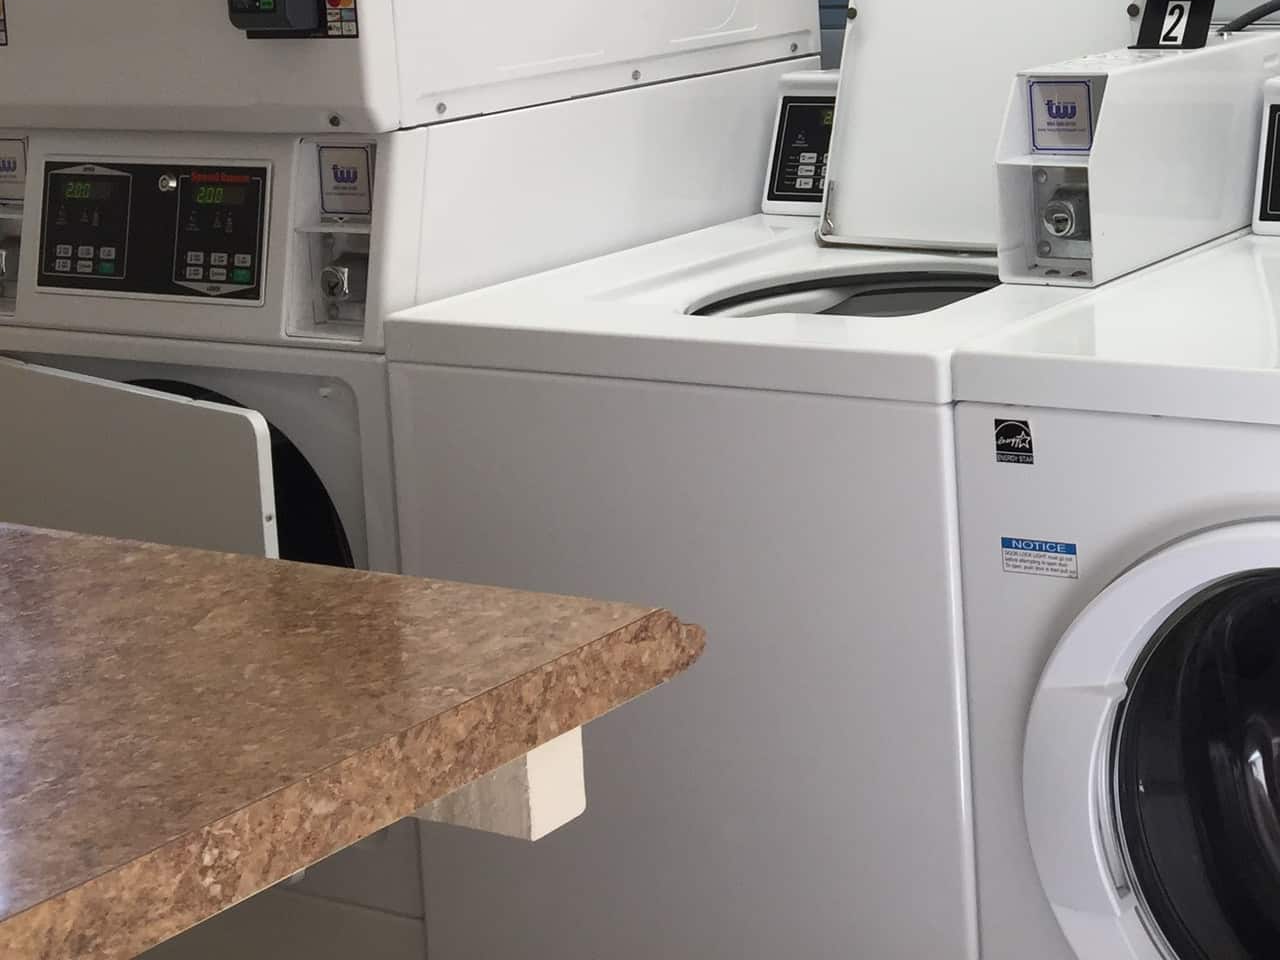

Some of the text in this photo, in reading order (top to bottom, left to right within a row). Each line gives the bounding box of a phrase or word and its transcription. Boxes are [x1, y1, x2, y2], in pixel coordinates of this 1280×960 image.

[1162, 4, 1185, 43] 2
[1045, 100, 1076, 119] tw
[1012, 540, 1067, 552] NOTICE
